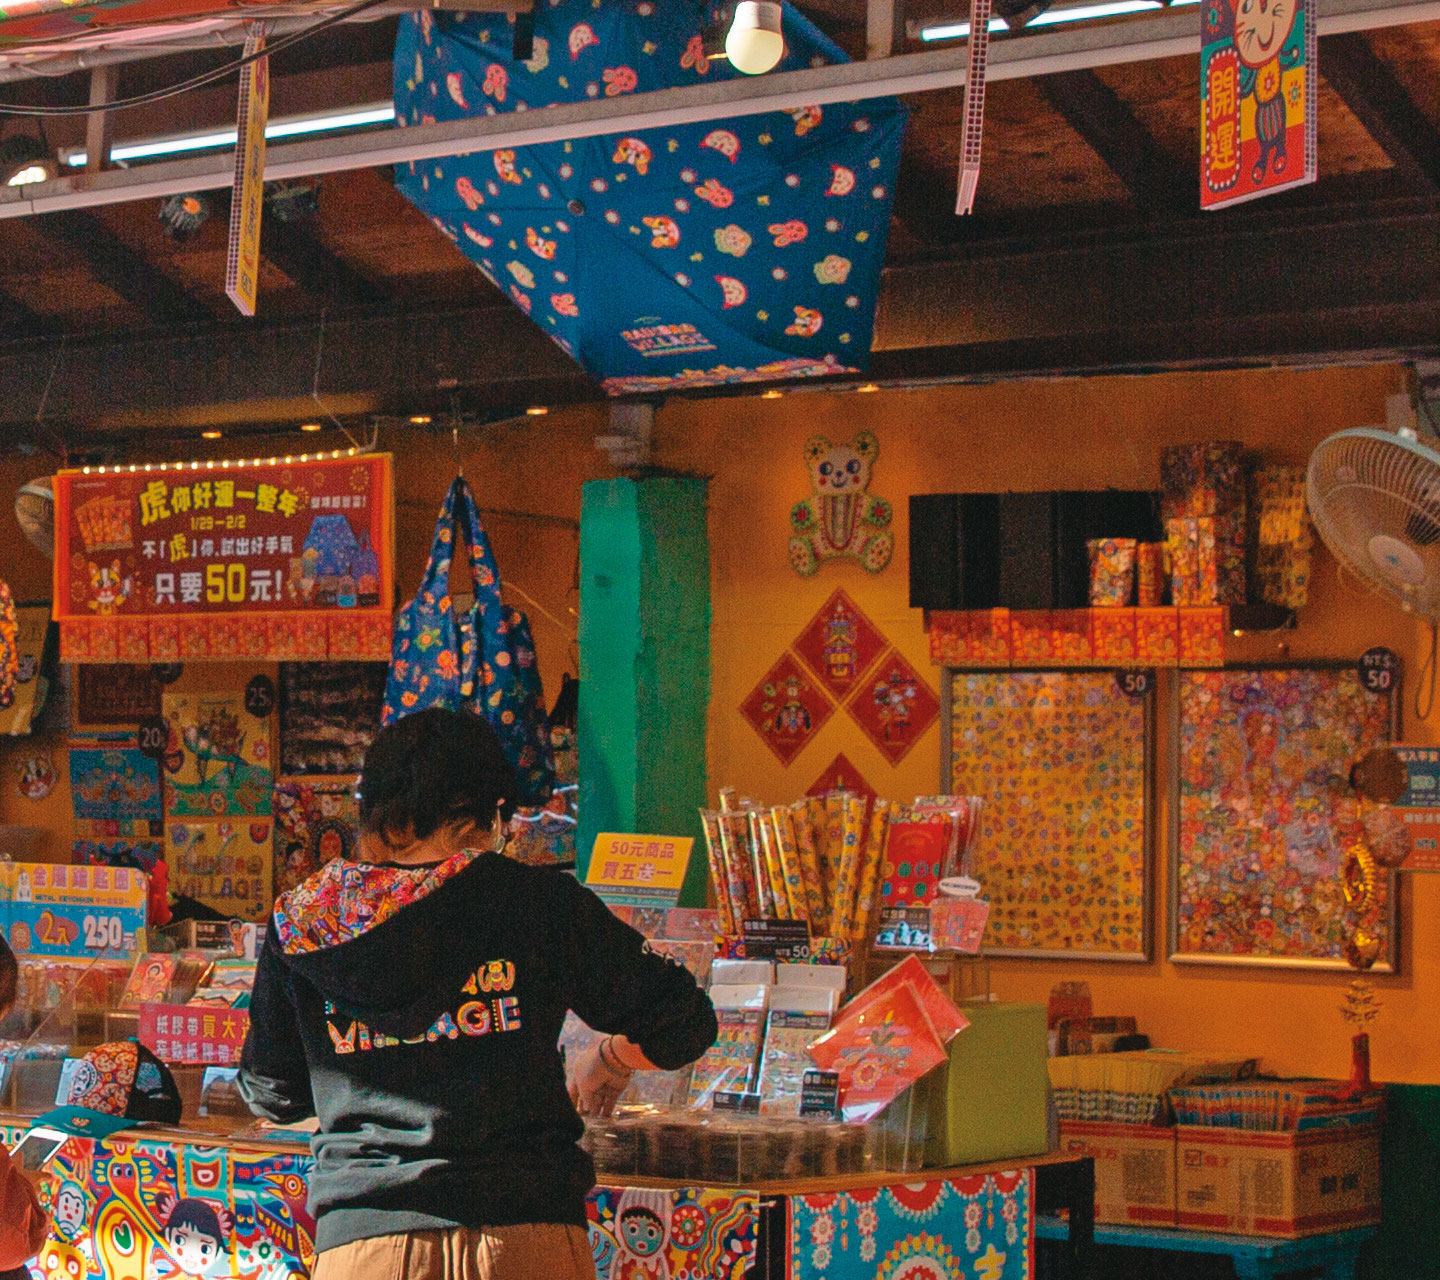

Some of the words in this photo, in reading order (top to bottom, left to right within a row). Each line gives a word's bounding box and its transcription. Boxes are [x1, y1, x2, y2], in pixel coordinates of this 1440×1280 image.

[1210, 66, 1235, 170] 開運
[139, 481, 299, 526] 虎你好運一整年
[155, 563, 283, 603] 只要50元!
[1125, 674, 1146, 692] 50
[1367, 671, 1390, 689] 50
[610, 840, 674, 859] 50元商品
[602, 861, 674, 882] 買五送一
[793, 944, 810, 959] 50
[327, 996, 521, 1054] VIAGE
